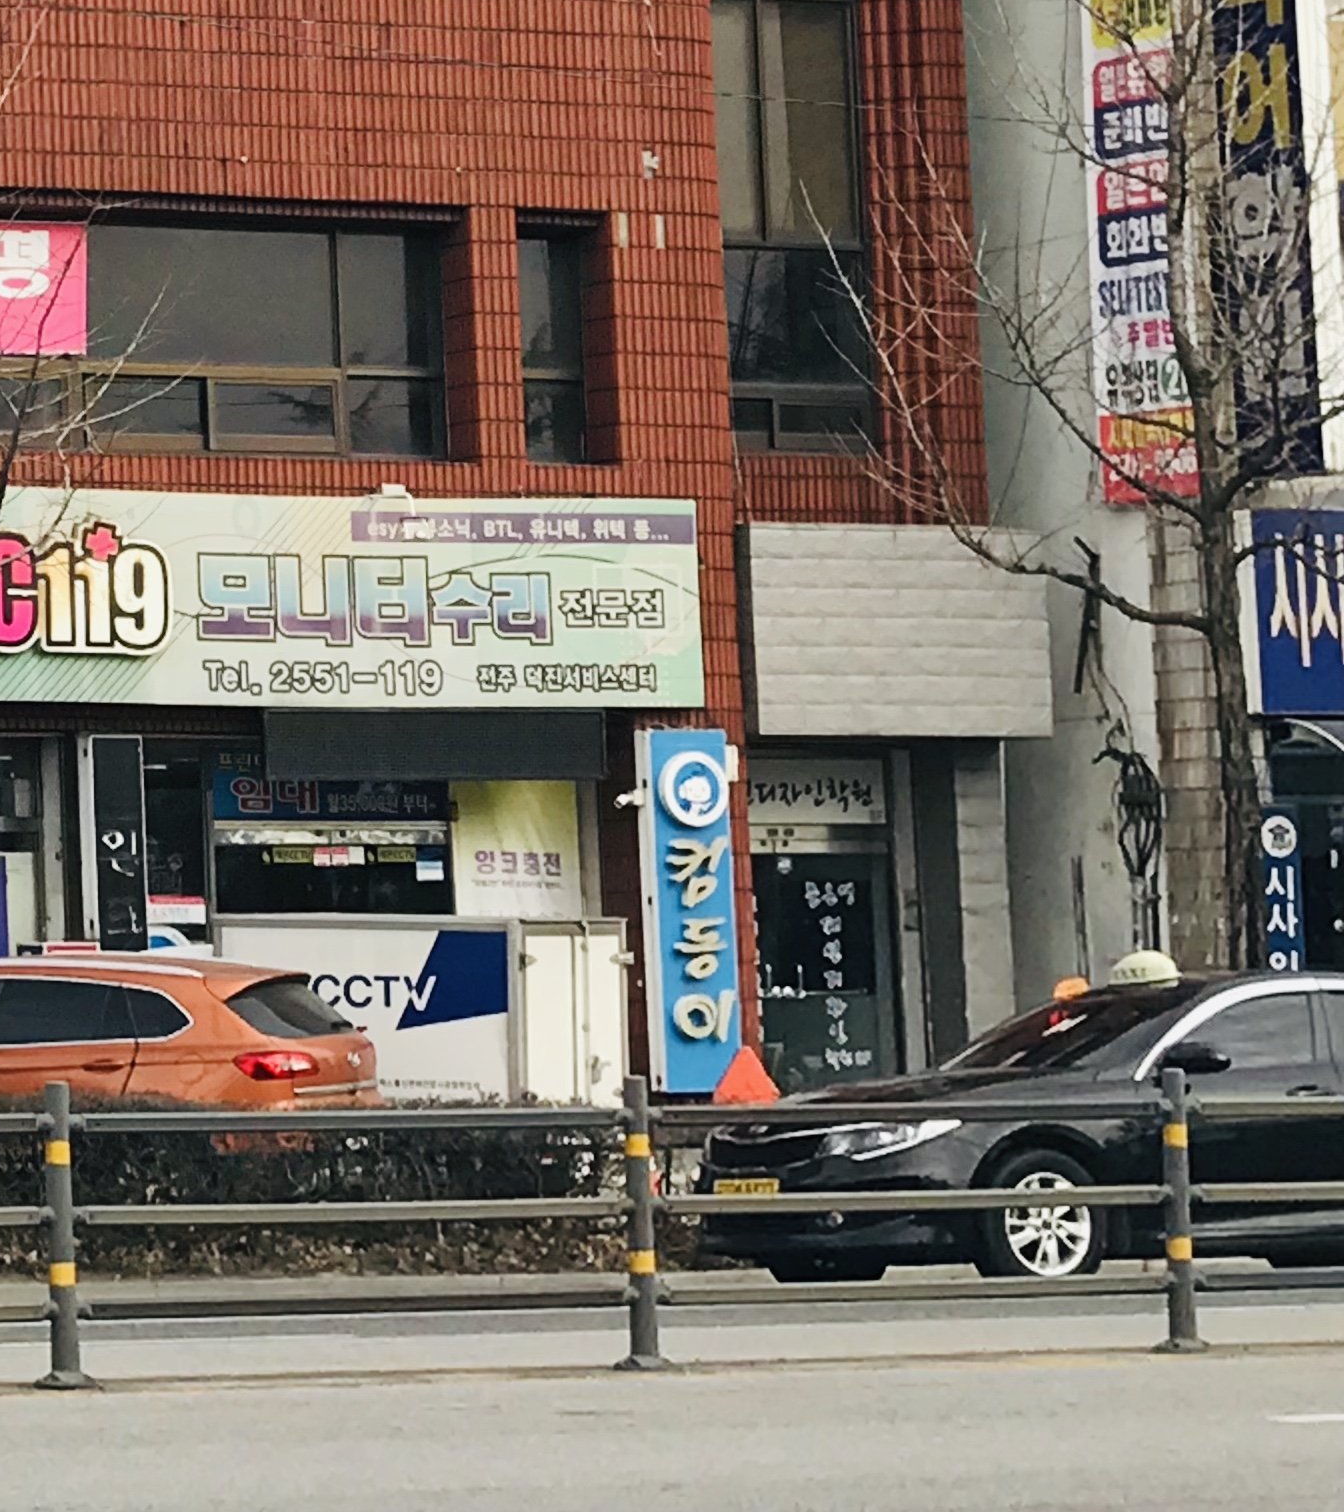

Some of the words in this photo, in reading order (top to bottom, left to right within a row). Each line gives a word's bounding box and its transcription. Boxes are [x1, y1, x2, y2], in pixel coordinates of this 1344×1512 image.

[197, 551, 553, 647] 모니터수리
[558, 588, 666, 630] 전문점
[269, 659, 444, 697] 2551-119
[477, 663, 517, 694] 전주
